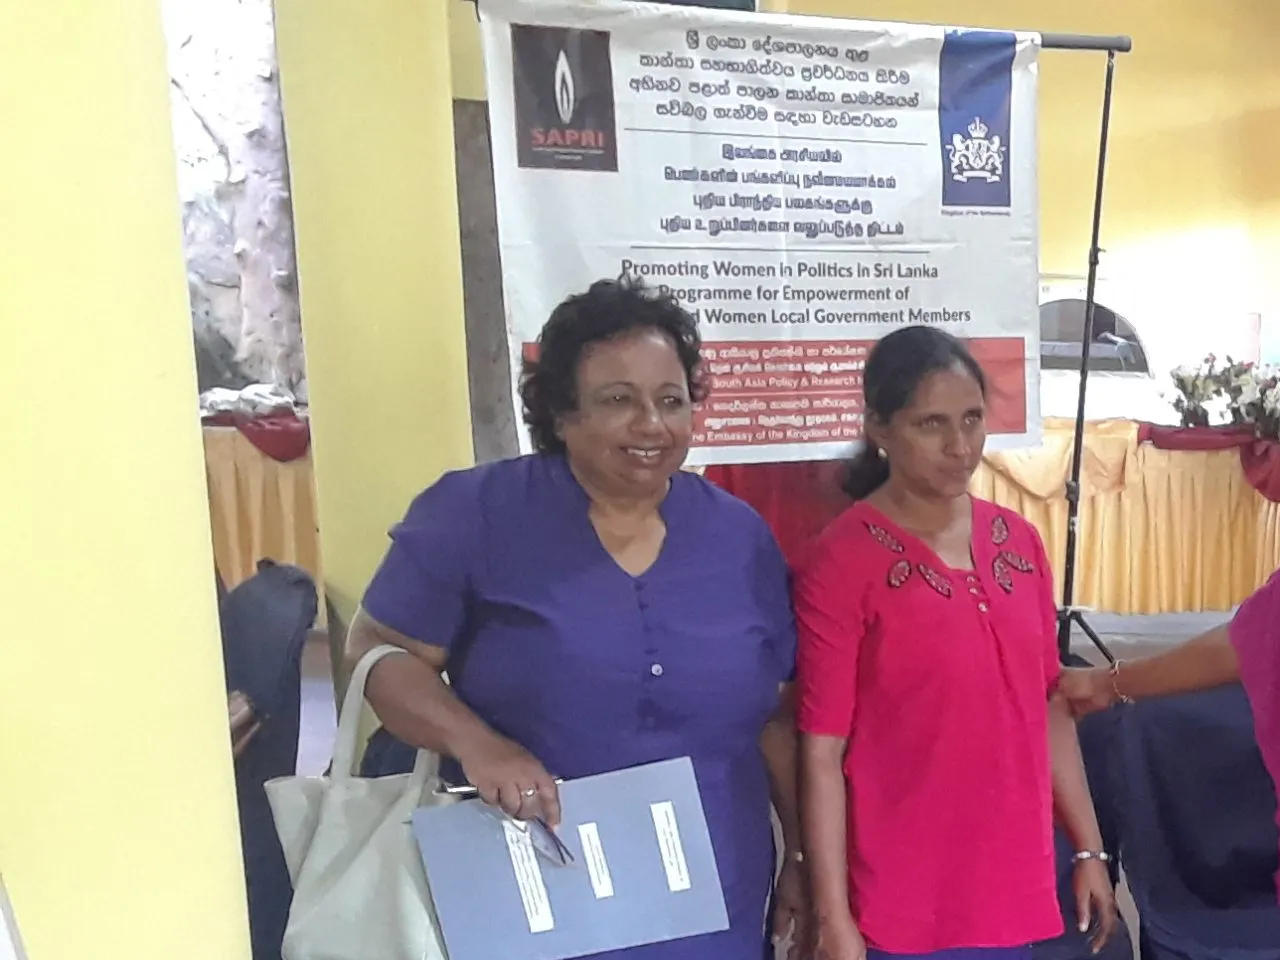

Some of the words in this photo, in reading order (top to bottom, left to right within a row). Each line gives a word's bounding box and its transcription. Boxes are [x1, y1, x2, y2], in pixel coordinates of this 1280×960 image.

[706, 35, 746, 51] ලංකා
[640, 51, 694, 69] කාන්තා
[737, 85, 779, 100] පාලන
[786, 86, 835, 102] කාන්තා
[531, 127, 604, 147] SAPRI
[622, 259, 709, 279] Promoting
[713, 260, 776, 277] Women
[780, 262, 792, 277] in
[798, 262, 853, 278] Politics
[857, 262, 870, 278] in
[873, 263, 893, 278] Sri
[897, 263, 938, 278] Lanka
[659, 284, 752, 303] Programme
[756, 285, 780, 301] for
[783, 285, 891, 303] Empowerment
[895, 286, 910, 301] of
[705, 308, 767, 324] Women
[771, 308, 809, 324] Local
[814, 308, 905, 324] Government
[908, 307, 971, 324] Members
